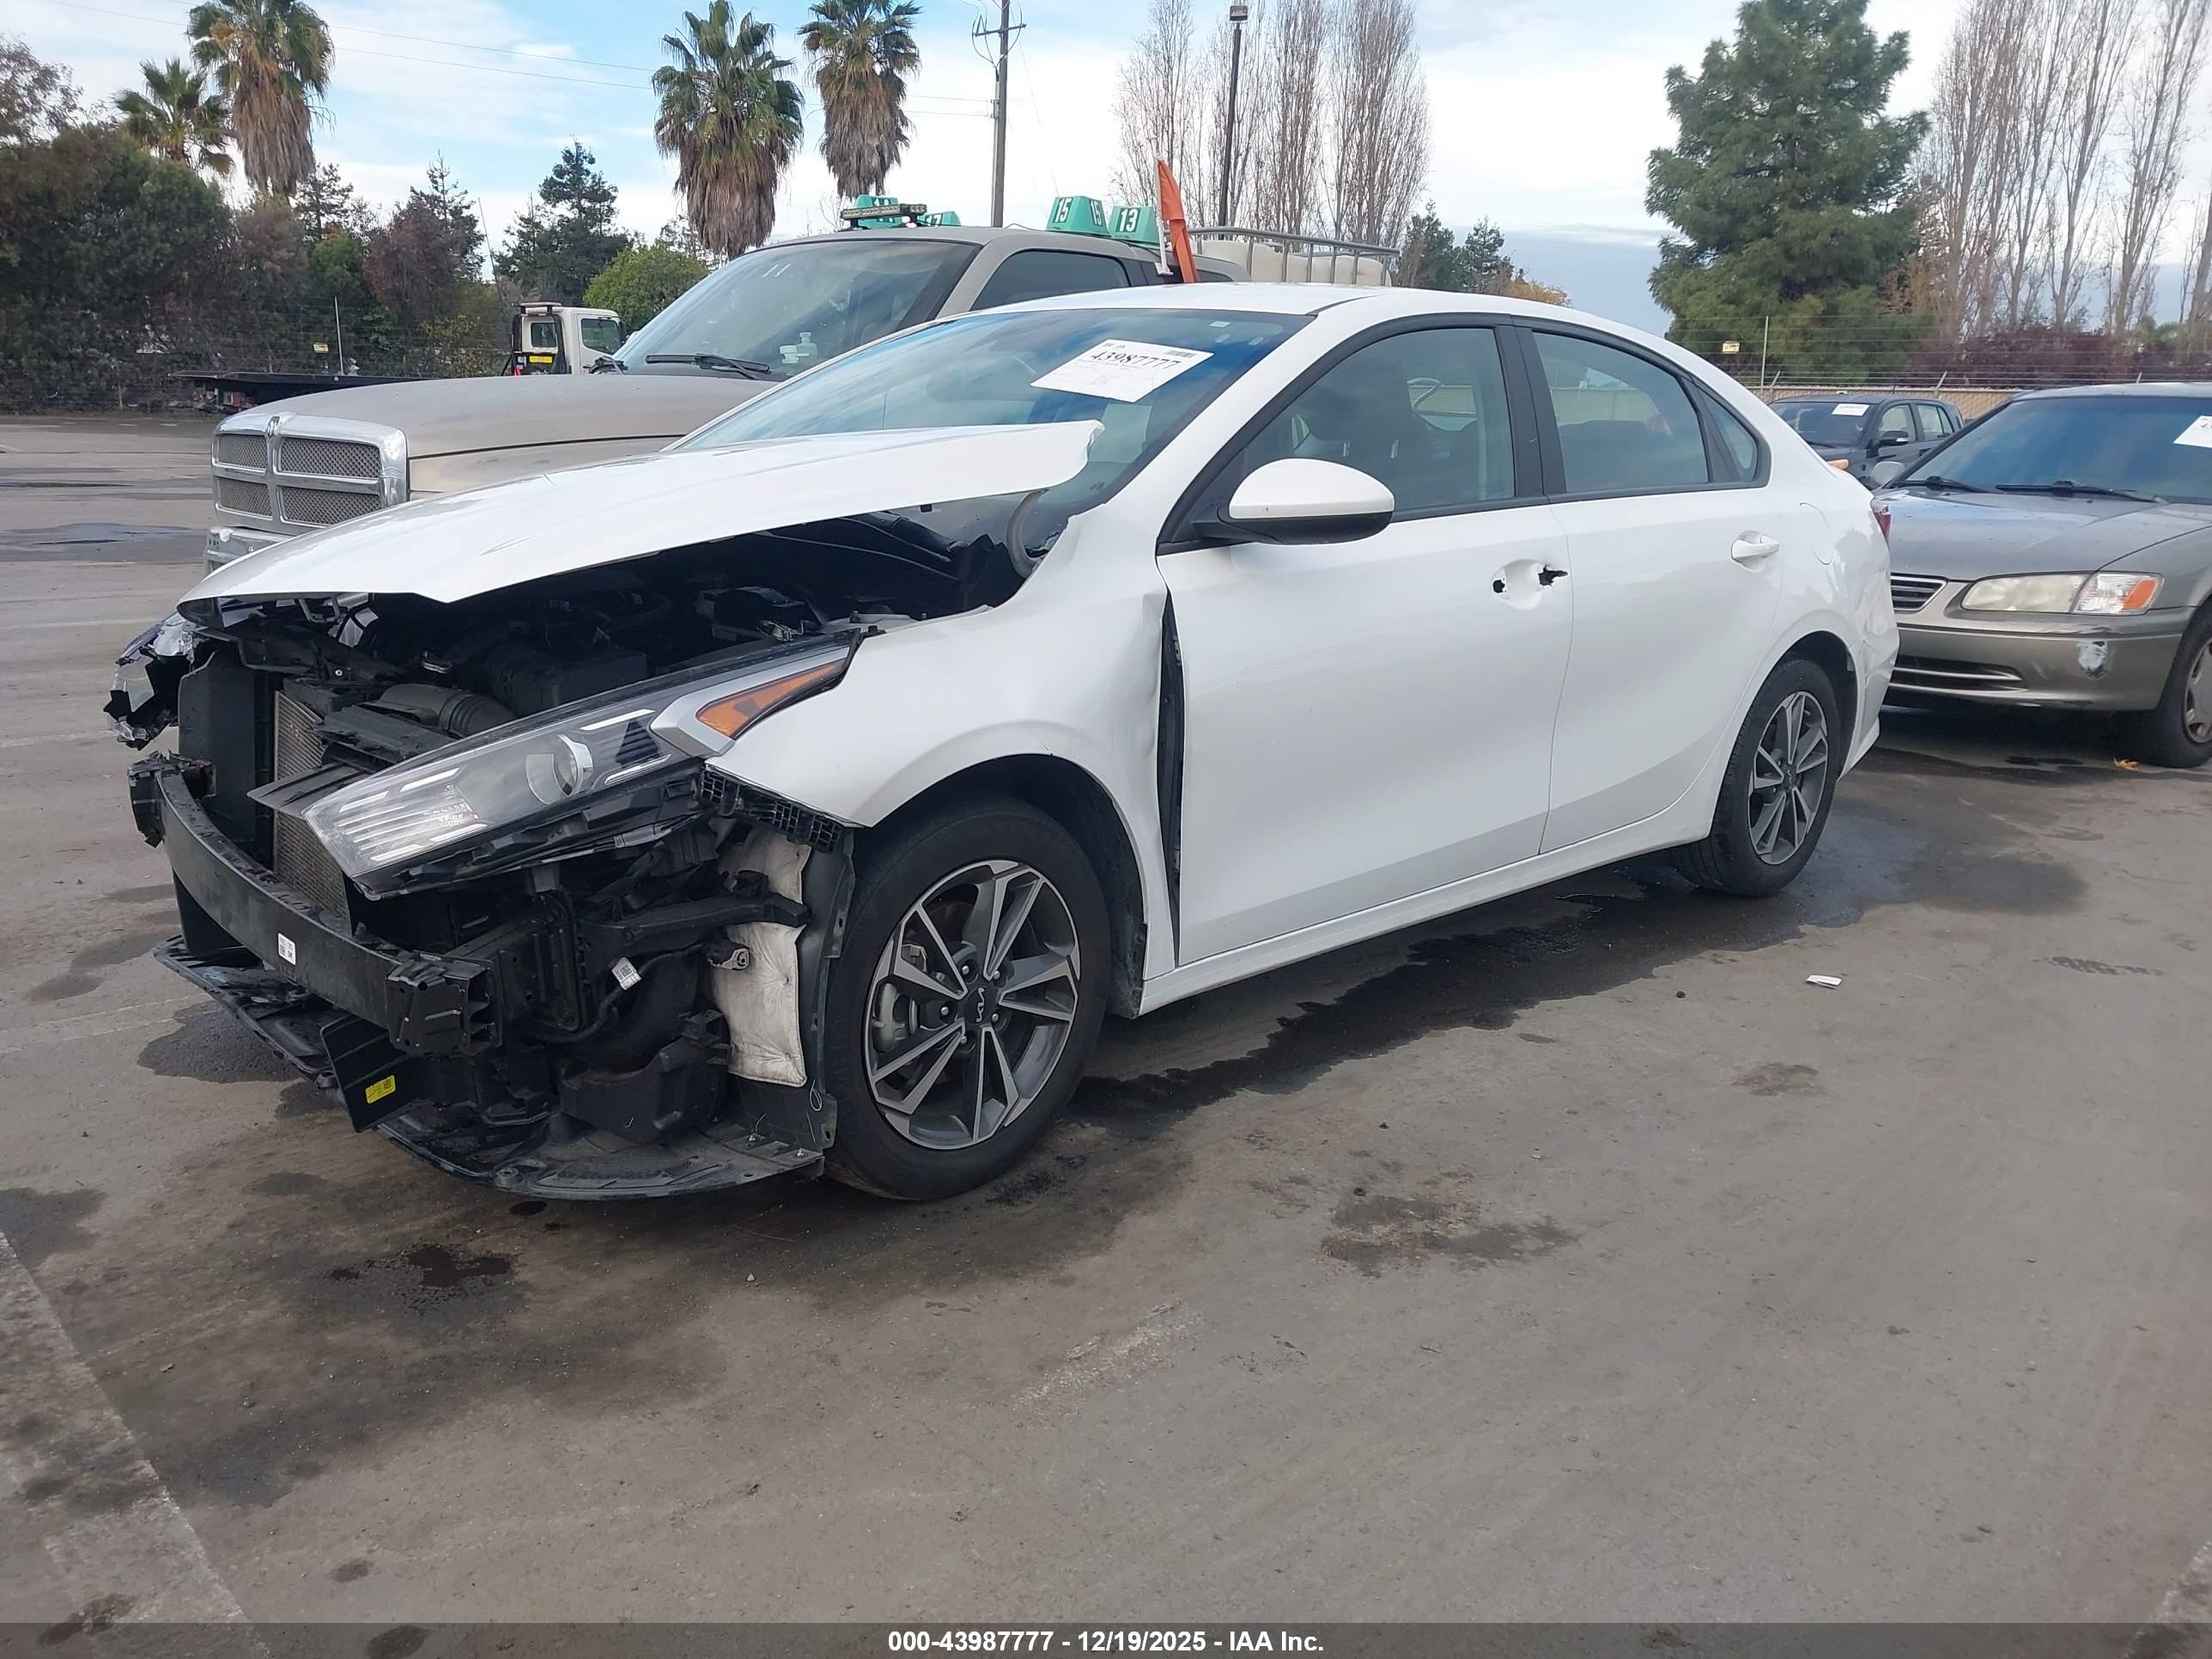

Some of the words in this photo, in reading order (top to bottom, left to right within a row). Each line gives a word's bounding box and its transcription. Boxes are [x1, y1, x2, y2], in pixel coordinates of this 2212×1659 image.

[1054, 198, 1073, 223] 15
[1090, 200, 1103, 226] 15
[1119, 208, 1139, 232] 13
[1091, 350, 1182, 370] 43987777
